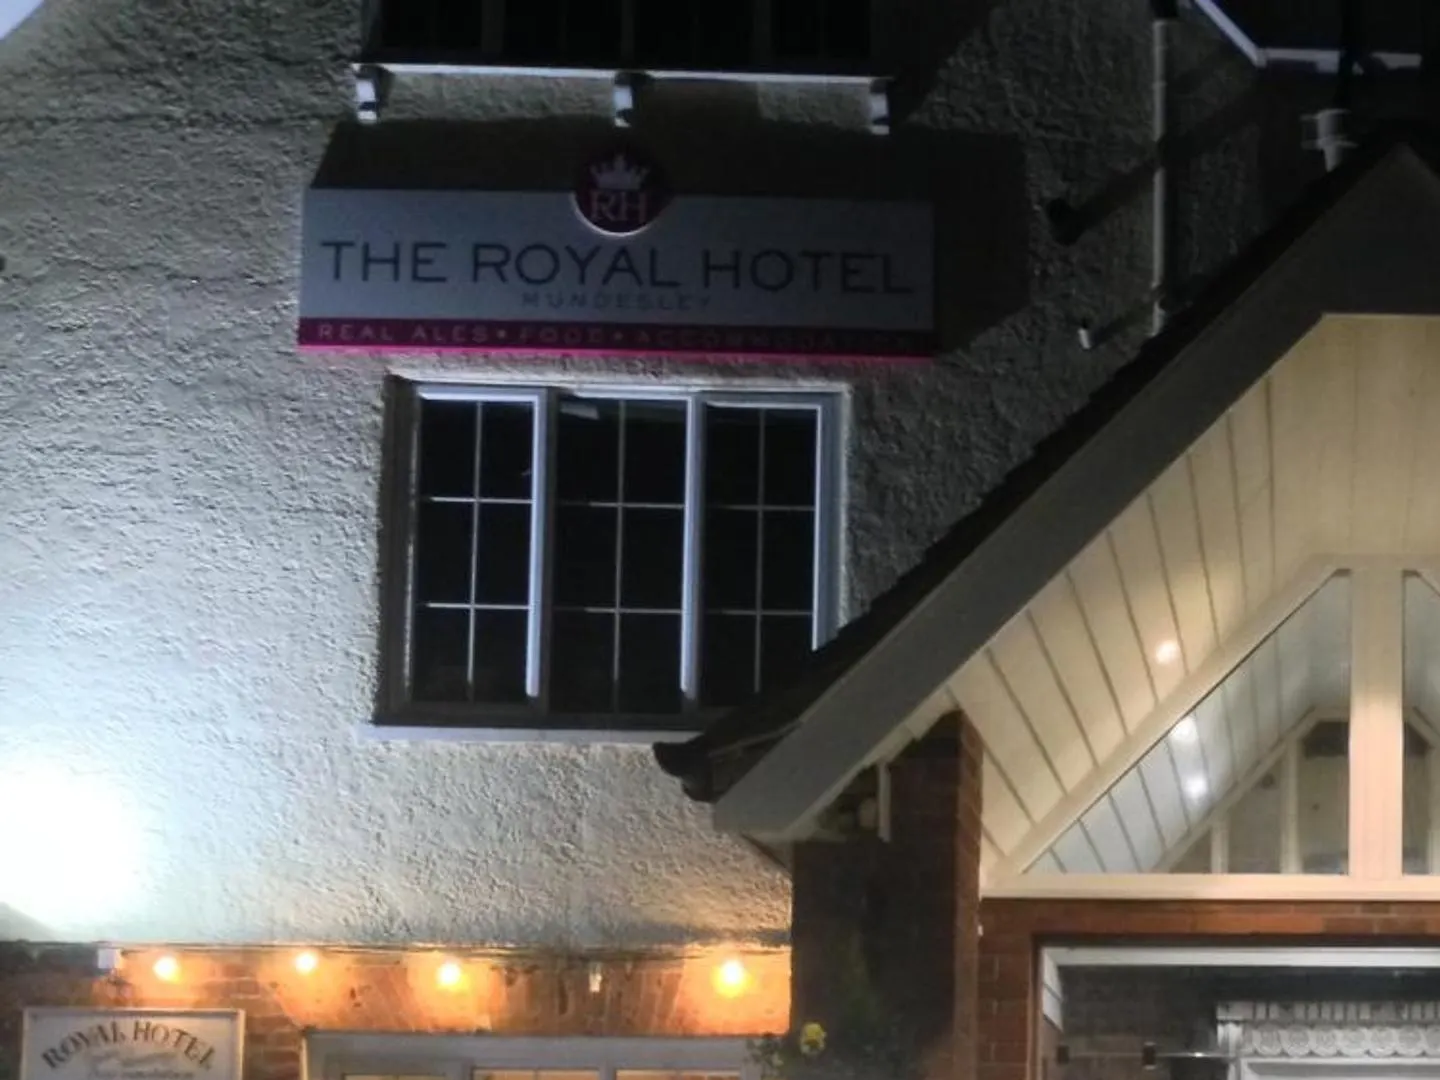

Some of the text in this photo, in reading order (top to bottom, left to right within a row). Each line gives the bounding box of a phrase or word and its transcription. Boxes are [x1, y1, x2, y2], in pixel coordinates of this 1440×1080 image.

[590, 189, 648, 224] RH
[320, 239, 915, 295] THE ROYAL HOTEL
[316, 323, 394, 342] REAL
[410, 324, 490, 344] ALES
[636, 328, 914, 351] ACCOMMODA
[41, 1020, 216, 1071] ROYAL HOTEL
